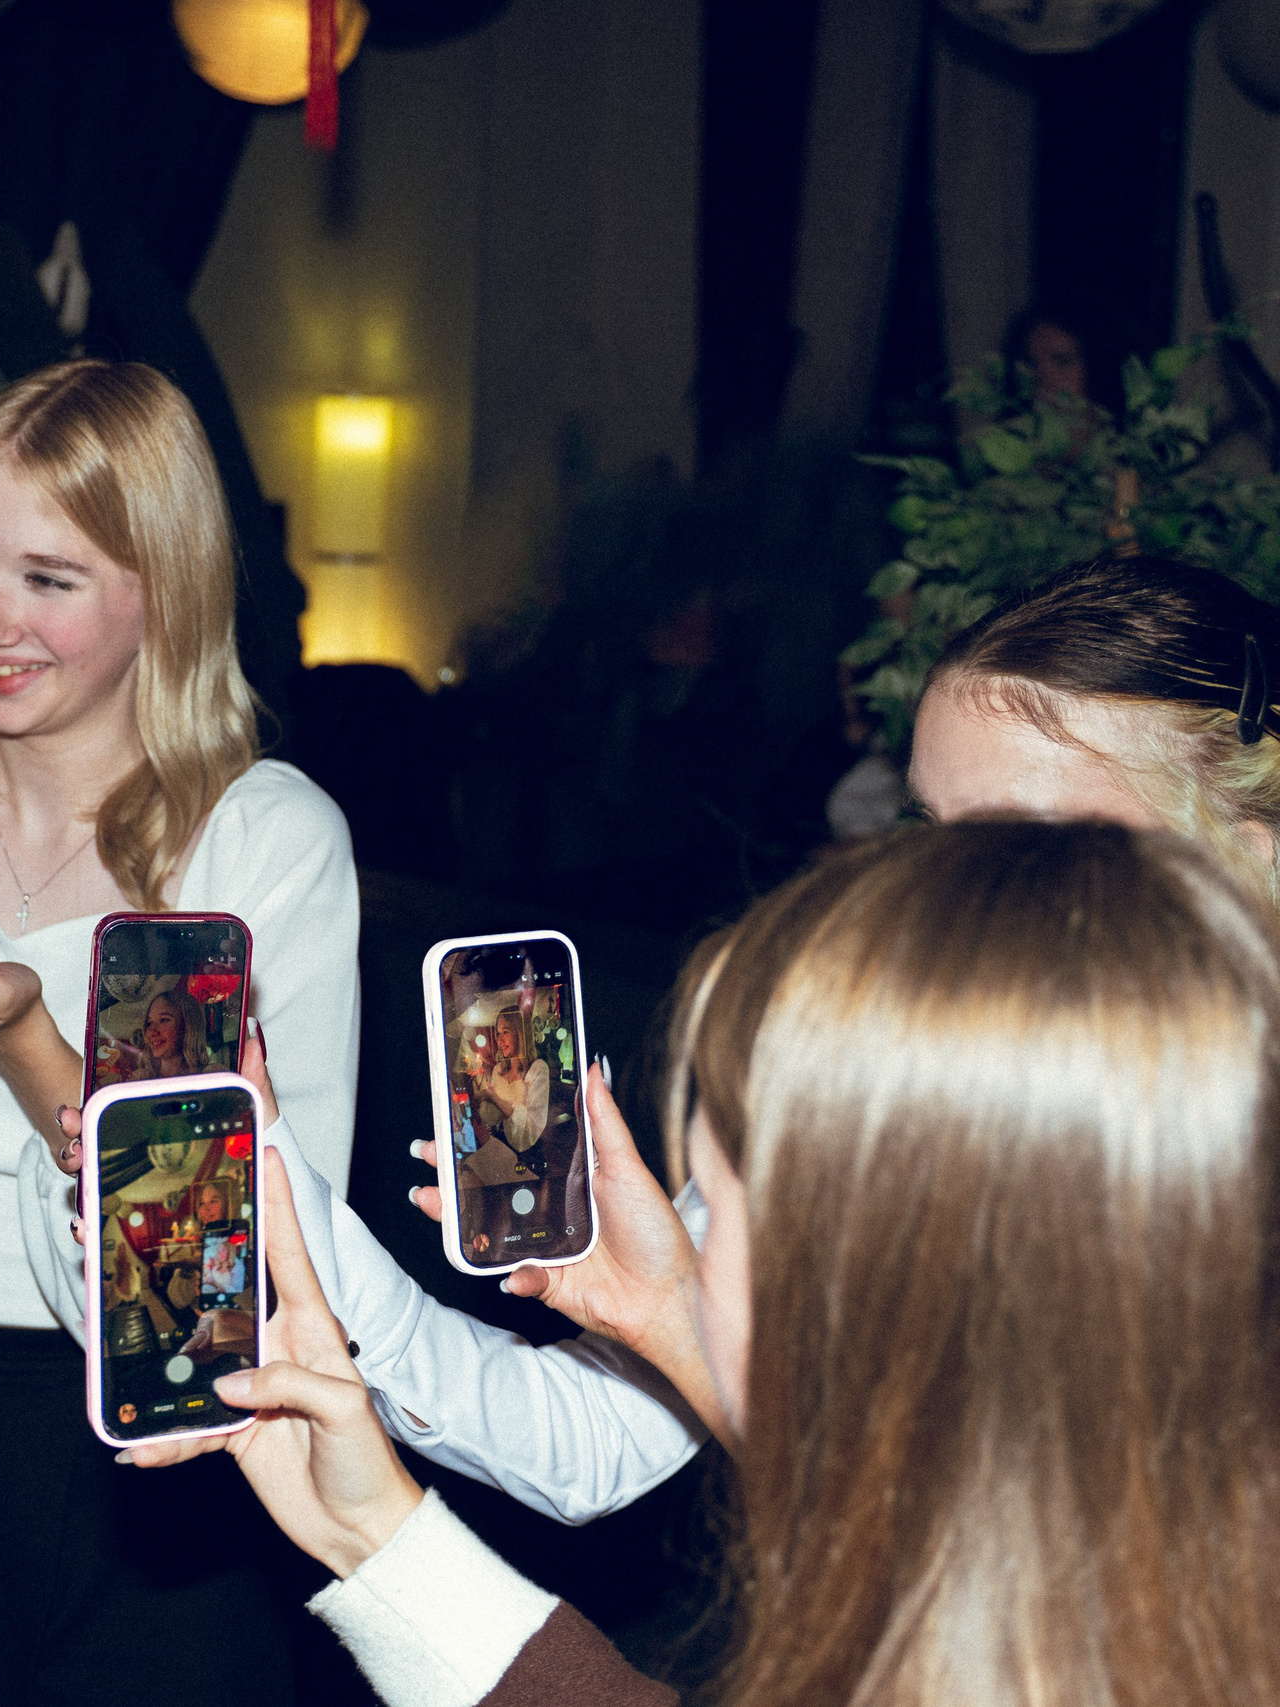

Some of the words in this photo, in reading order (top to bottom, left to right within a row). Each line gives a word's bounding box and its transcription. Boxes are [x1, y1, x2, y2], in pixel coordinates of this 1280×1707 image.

[504, 1234, 521, 1243] ВИДЕО
[532, 1231, 546, 1239] ФОТО
[187, 1399, 204, 1408] ФОТО
